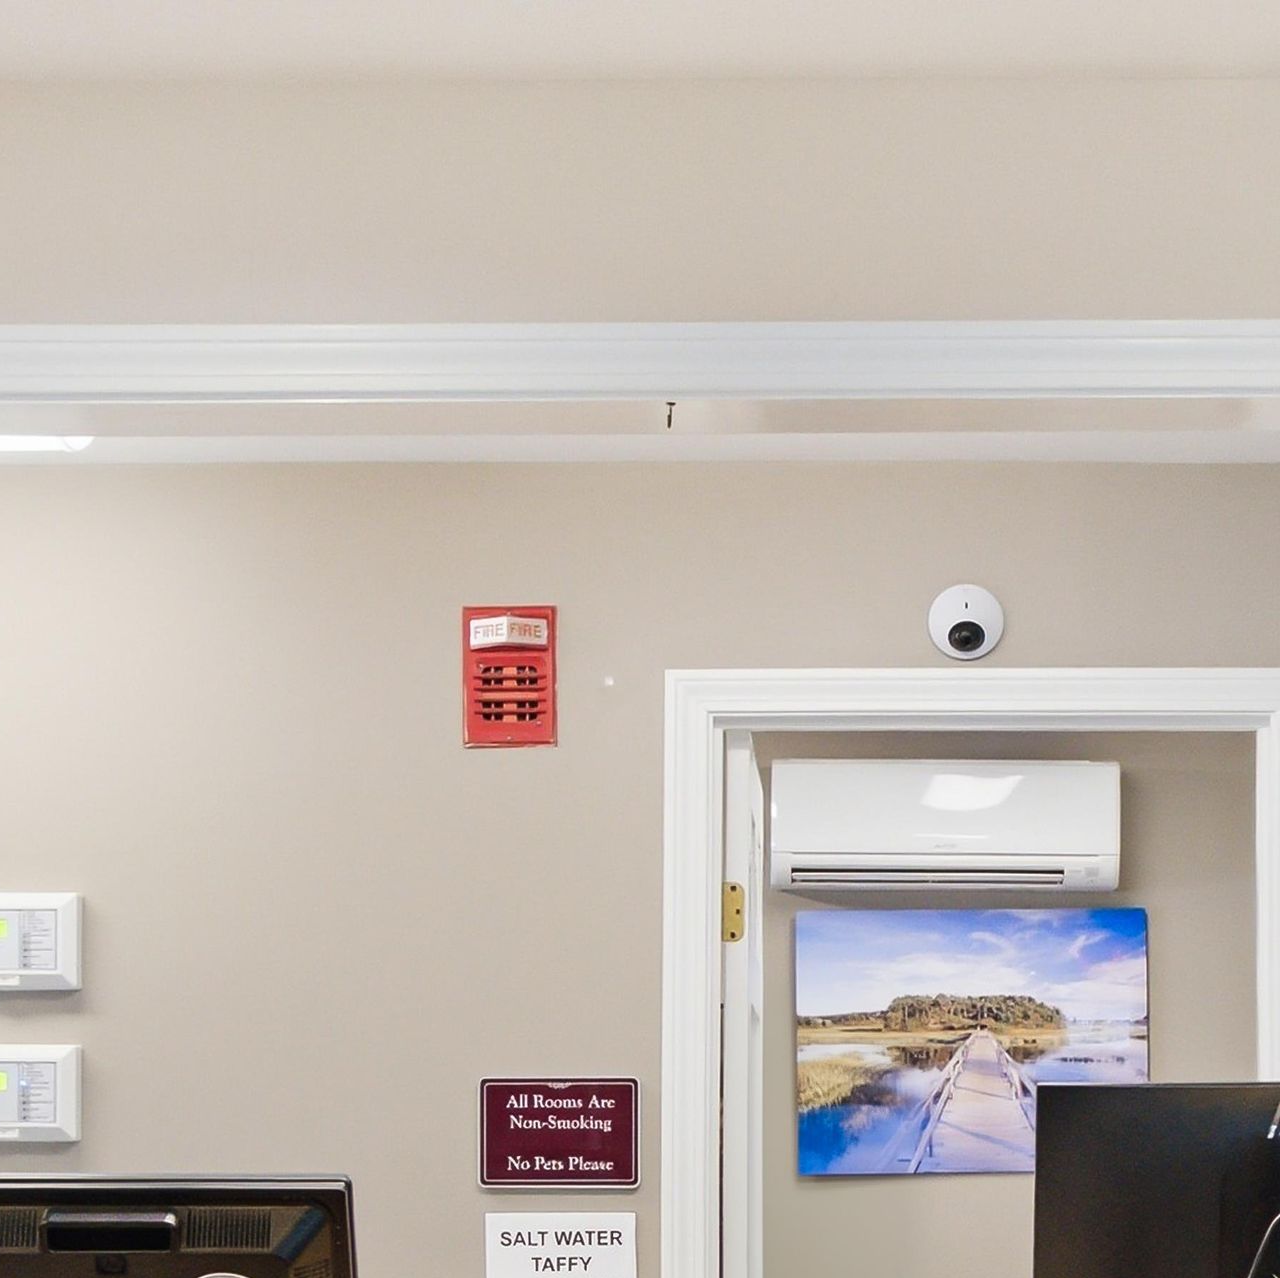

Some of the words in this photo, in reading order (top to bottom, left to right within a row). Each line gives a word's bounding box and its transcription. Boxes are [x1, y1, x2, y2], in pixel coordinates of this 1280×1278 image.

[474, 623, 505, 640] FIRE
[510, 622, 542, 639] FIRE
[506, 1094, 528, 1109] All
[533, 1094, 583, 1109] Rooms
[588, 1094, 616, 1109] Are
[510, 1115, 612, 1132] Non-Smoking
[507, 1156, 531, 1171] No
[534, 1156, 564, 1171] Pets
[568, 1156, 614, 1171] Please
[500, 1231, 548, 1247] SALT
[554, 1230, 622, 1246] WATER
[531, 1256, 592, 1272] TAFFY
